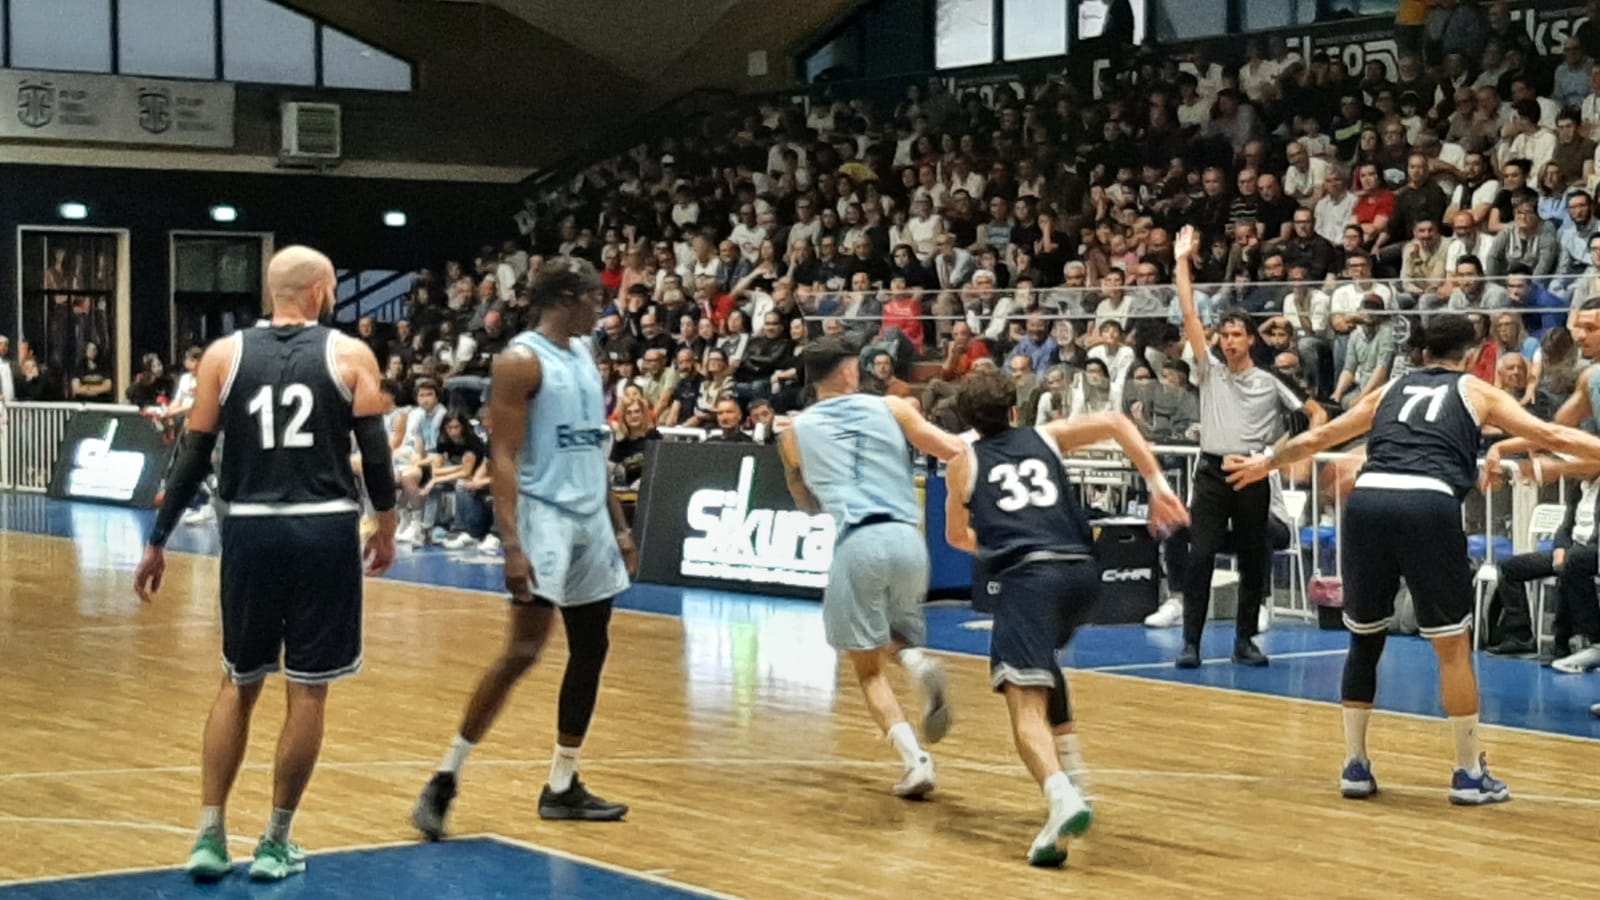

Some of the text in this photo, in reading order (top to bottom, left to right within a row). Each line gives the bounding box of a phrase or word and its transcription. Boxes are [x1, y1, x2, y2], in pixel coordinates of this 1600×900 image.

[248, 383, 314, 450] 12
[1398, 384, 1449, 422] 71
[683, 456, 835, 572] Sikura
[988, 458, 1059, 512] 33
